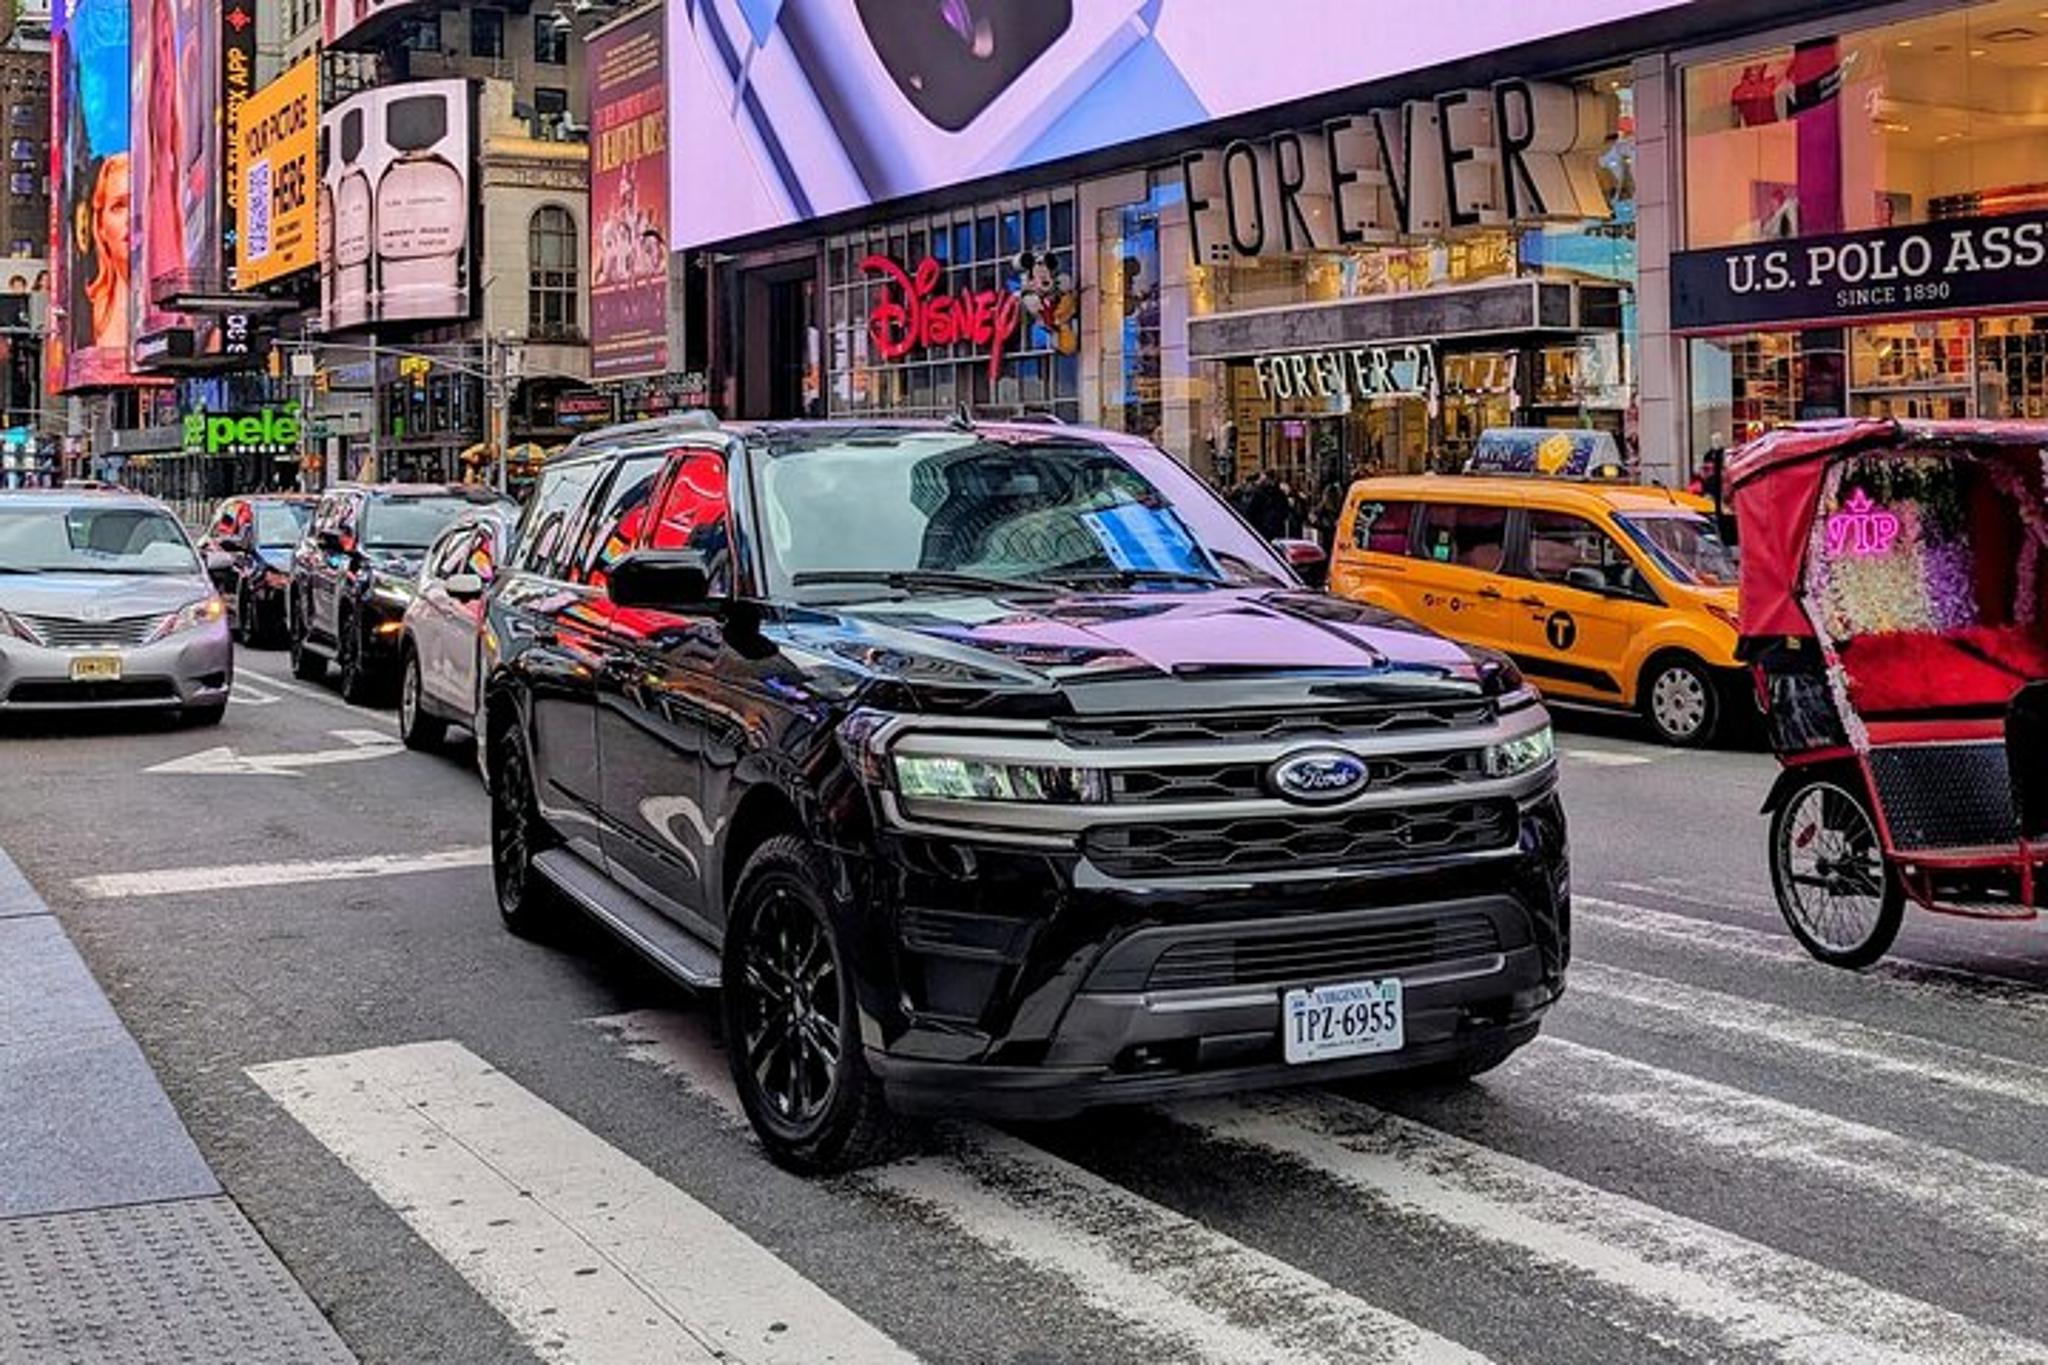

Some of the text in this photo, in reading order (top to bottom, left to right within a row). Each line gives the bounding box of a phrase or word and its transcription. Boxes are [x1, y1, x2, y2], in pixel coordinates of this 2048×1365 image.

[227, 47, 248, 86] APP
[272, 153, 306, 219] HERE
[1181, 76, 1547, 266] FOREVER
[1726, 222, 2048, 293] U.S. POLO ASS
[1836, 281, 1951, 308] SINCE 1890
[1254, 346, 1393, 399] FOREVER
[1827, 514, 1898, 555] VIP
[1552, 618, 1571, 647] T
[1286, 762, 1356, 789] Ford
[1316, 987, 1372, 1004] VIRGINIA
[1293, 1000, 1397, 1044] TPZ-6955
